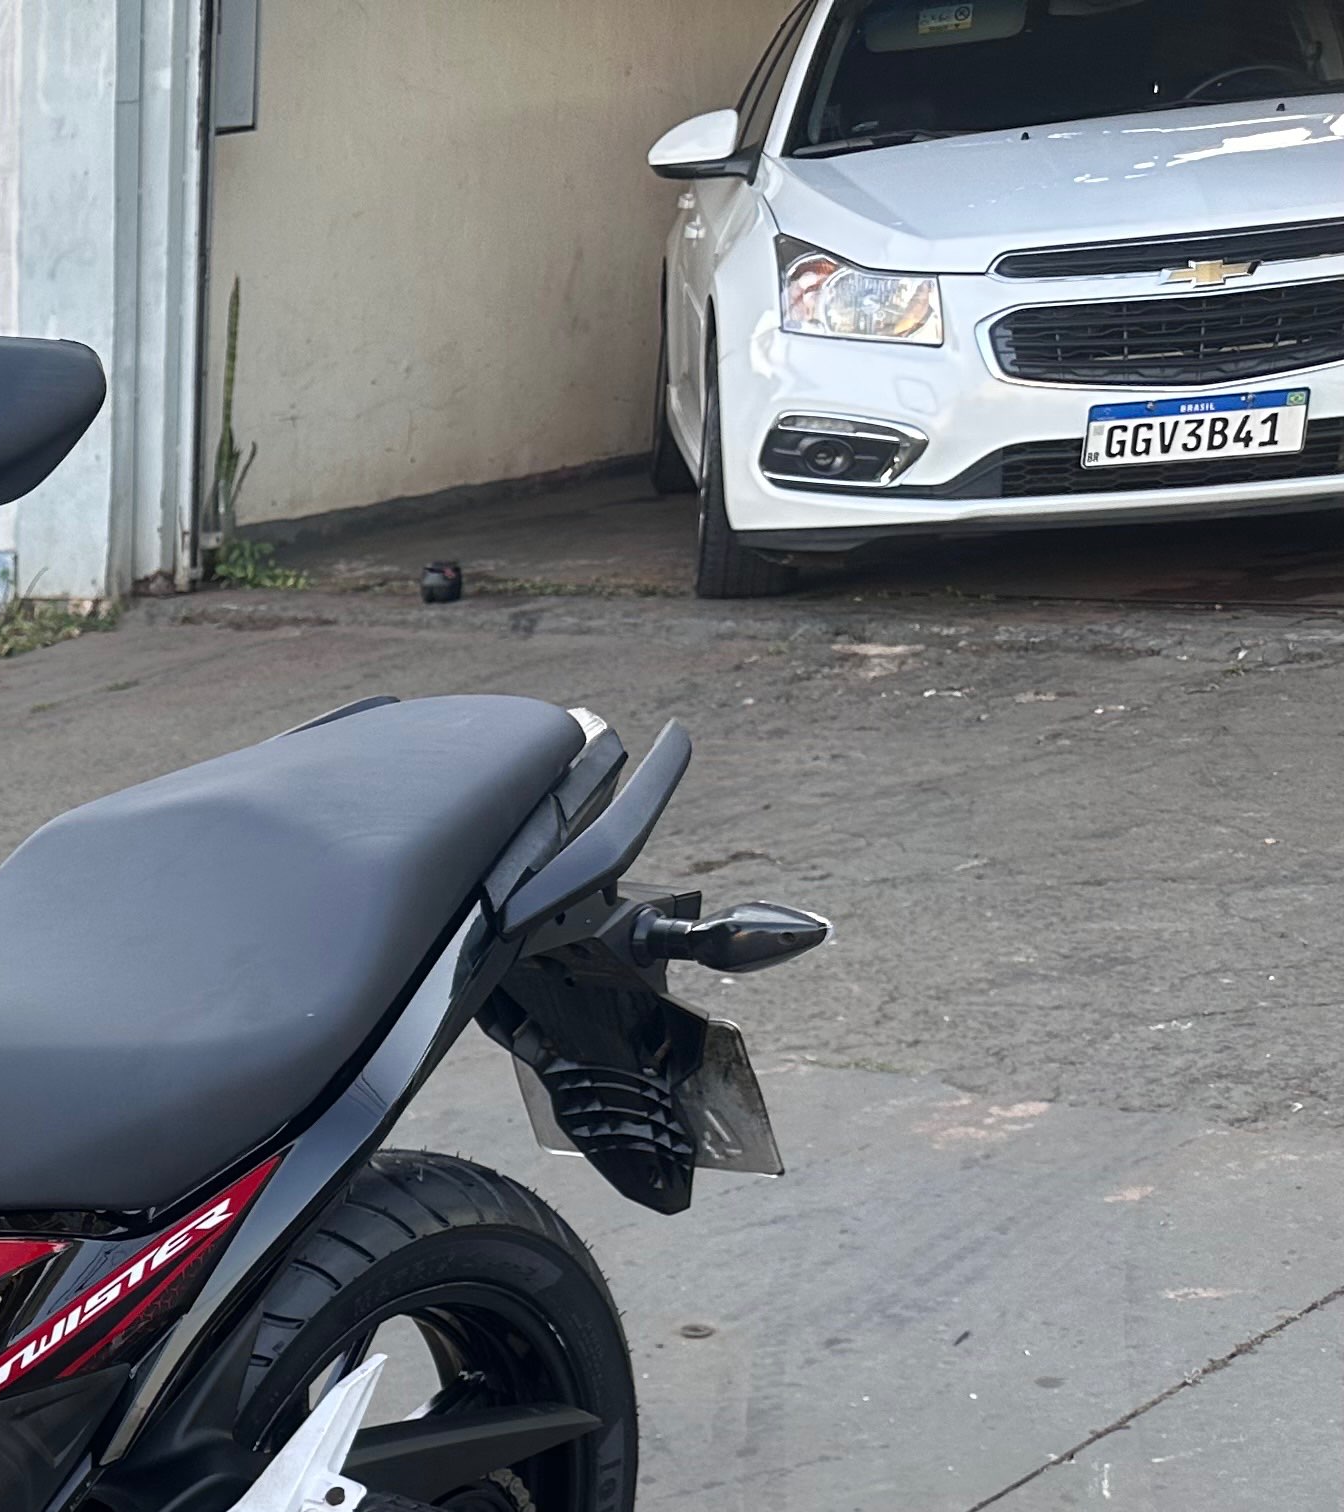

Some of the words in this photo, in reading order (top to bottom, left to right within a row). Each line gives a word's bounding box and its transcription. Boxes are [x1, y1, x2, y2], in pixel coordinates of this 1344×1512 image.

[1179, 402, 1216, 413] BRASIL
[1104, 412, 1280, 459] GGV3B41
[1086, 451, 1100, 464] BR
